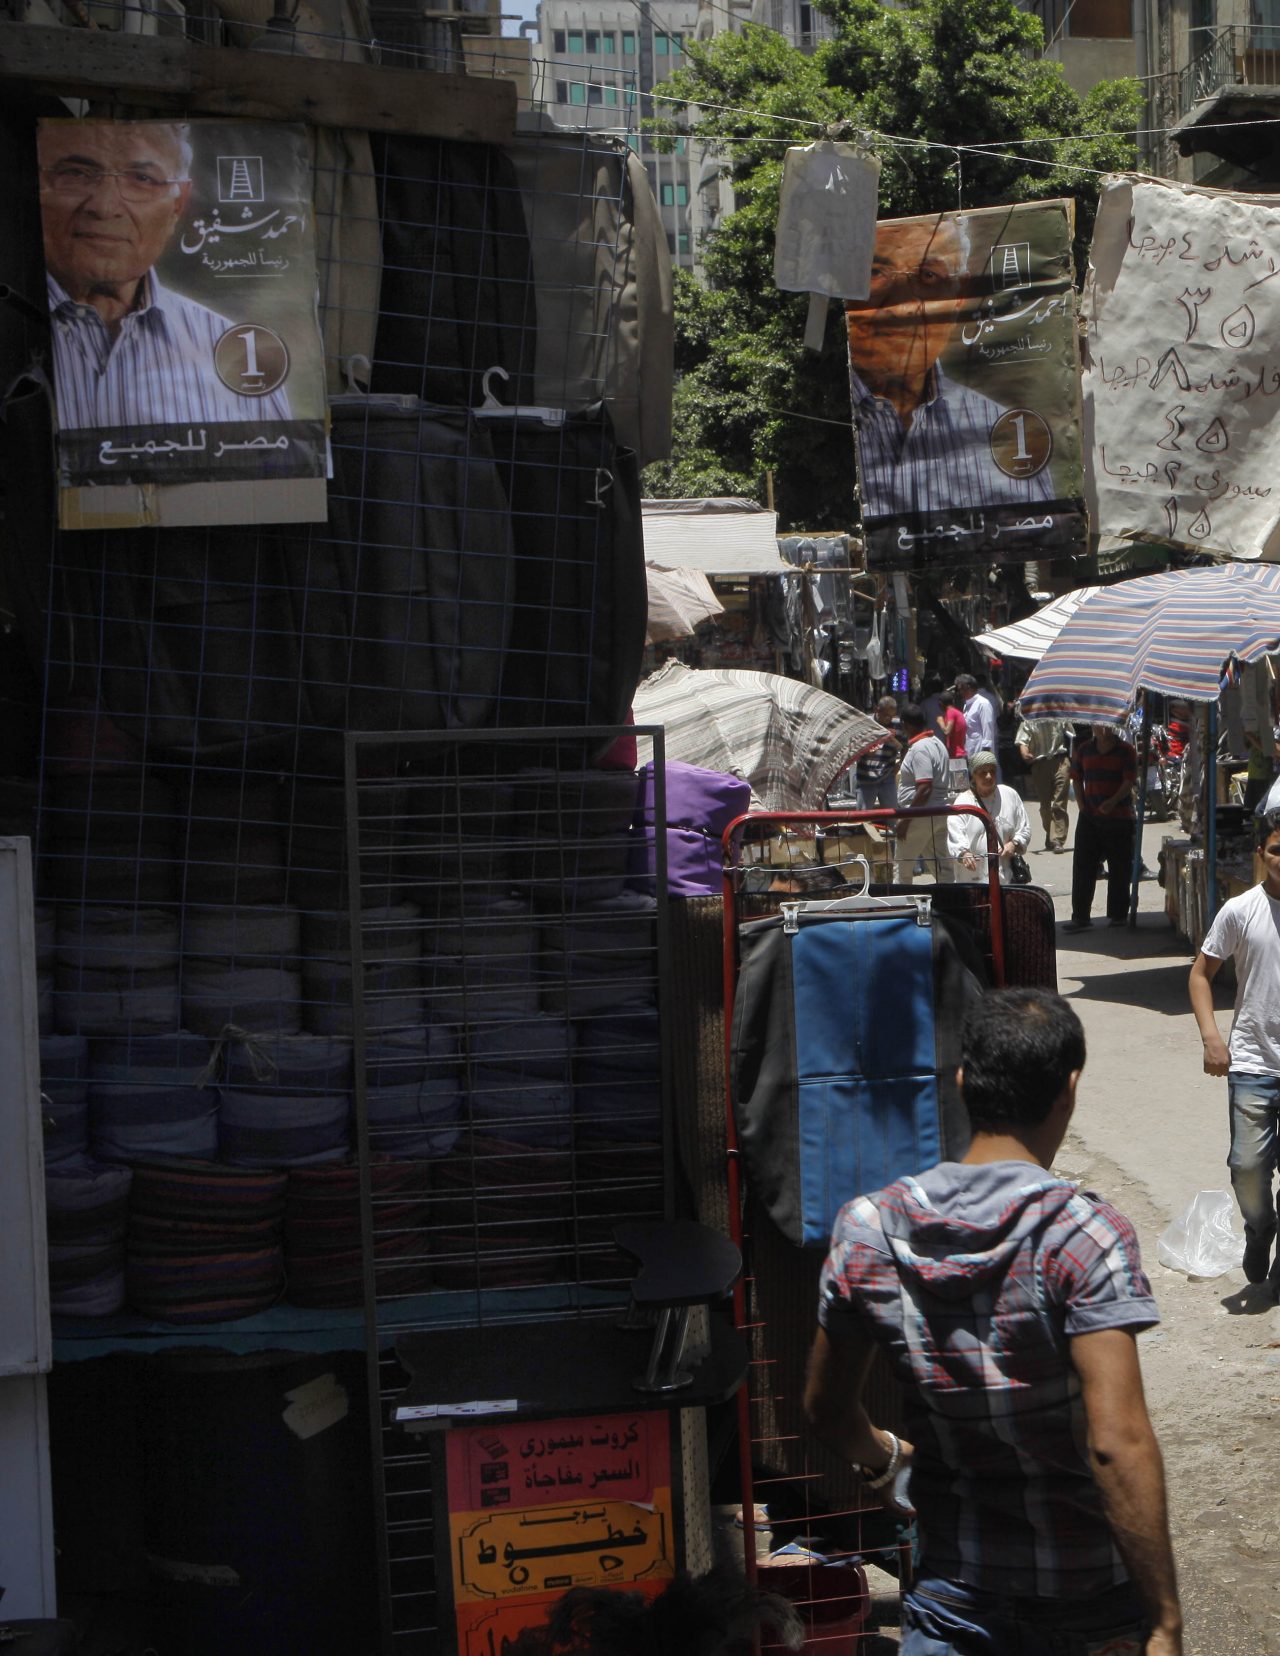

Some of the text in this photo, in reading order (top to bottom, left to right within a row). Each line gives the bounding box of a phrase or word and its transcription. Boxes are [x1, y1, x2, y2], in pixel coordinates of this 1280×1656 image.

[181, 206, 281, 254] شفيق
[201, 251, 258, 271] للجمهورية
[962, 296, 1044, 345] شفيق
[238, 329, 264, 377] 1
[978, 340, 1027, 357] للجمهورية
[99, 429, 289, 464] مصر للجميع
[1009, 415, 1033, 461] 1
[898, 514, 1054, 550] مصر للجميع
[590, 1421, 639, 1450] كروت
[588, 1459, 640, 1489] السعر
[519, 1507, 607, 1527] يوجد
[478, 1519, 649, 1568] خطوط
